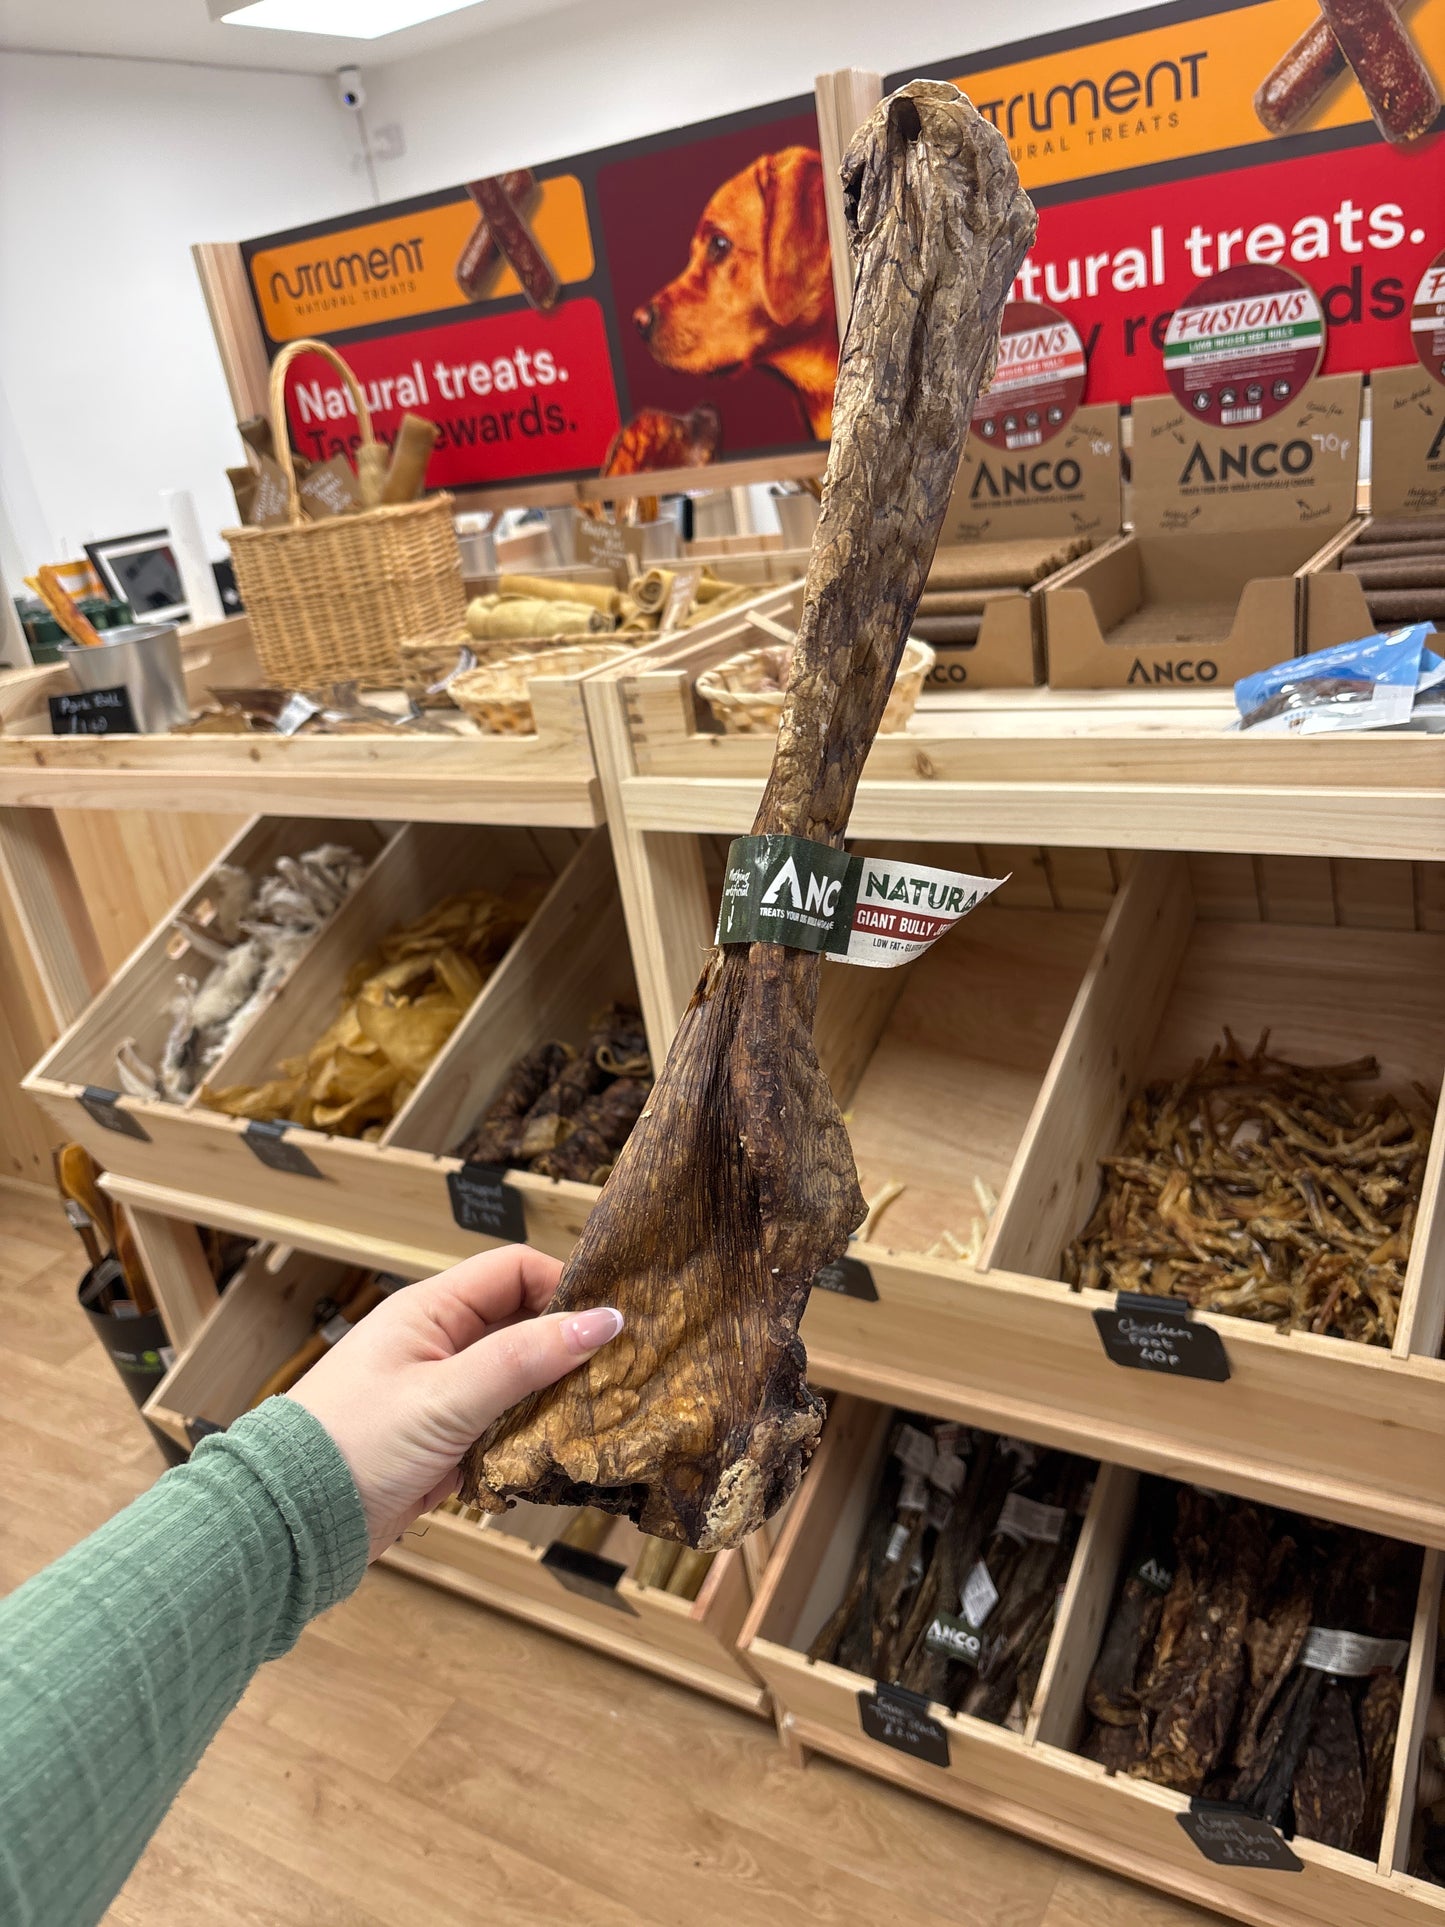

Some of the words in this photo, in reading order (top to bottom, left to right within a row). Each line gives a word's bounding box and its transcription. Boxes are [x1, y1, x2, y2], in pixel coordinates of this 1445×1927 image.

[978, 51, 1208, 139] TrimenT
[1012, 137, 1071, 162] URAL
[1087, 112, 1180, 146] TREATS
[1011, 225, 1166, 304] tural
[1184, 200, 1426, 278] treats.
[1177, 293, 1308, 339] FUSIONS
[999, 326, 1069, 363] SIONS
[295, 359, 430, 424] Natural
[433, 347, 569, 401] treats.
[432, 395, 577, 452] ewards.
[969, 457, 1082, 499] ANCO
[1178, 439, 1313, 486] ANCO
[1128, 658, 1219, 684] ANCO
[760, 856, 842, 917] ANC
[759, 907, 785, 919] TREATS
[786, 910, 800, 921] YOUR
[856, 909, 897, 931] GIANT
[899, 916, 935, 937] BULLY
[872, 938, 889, 949] LOW
[889, 940, 902, 951] FAT
[927, 1618, 980, 1652] ANCO
